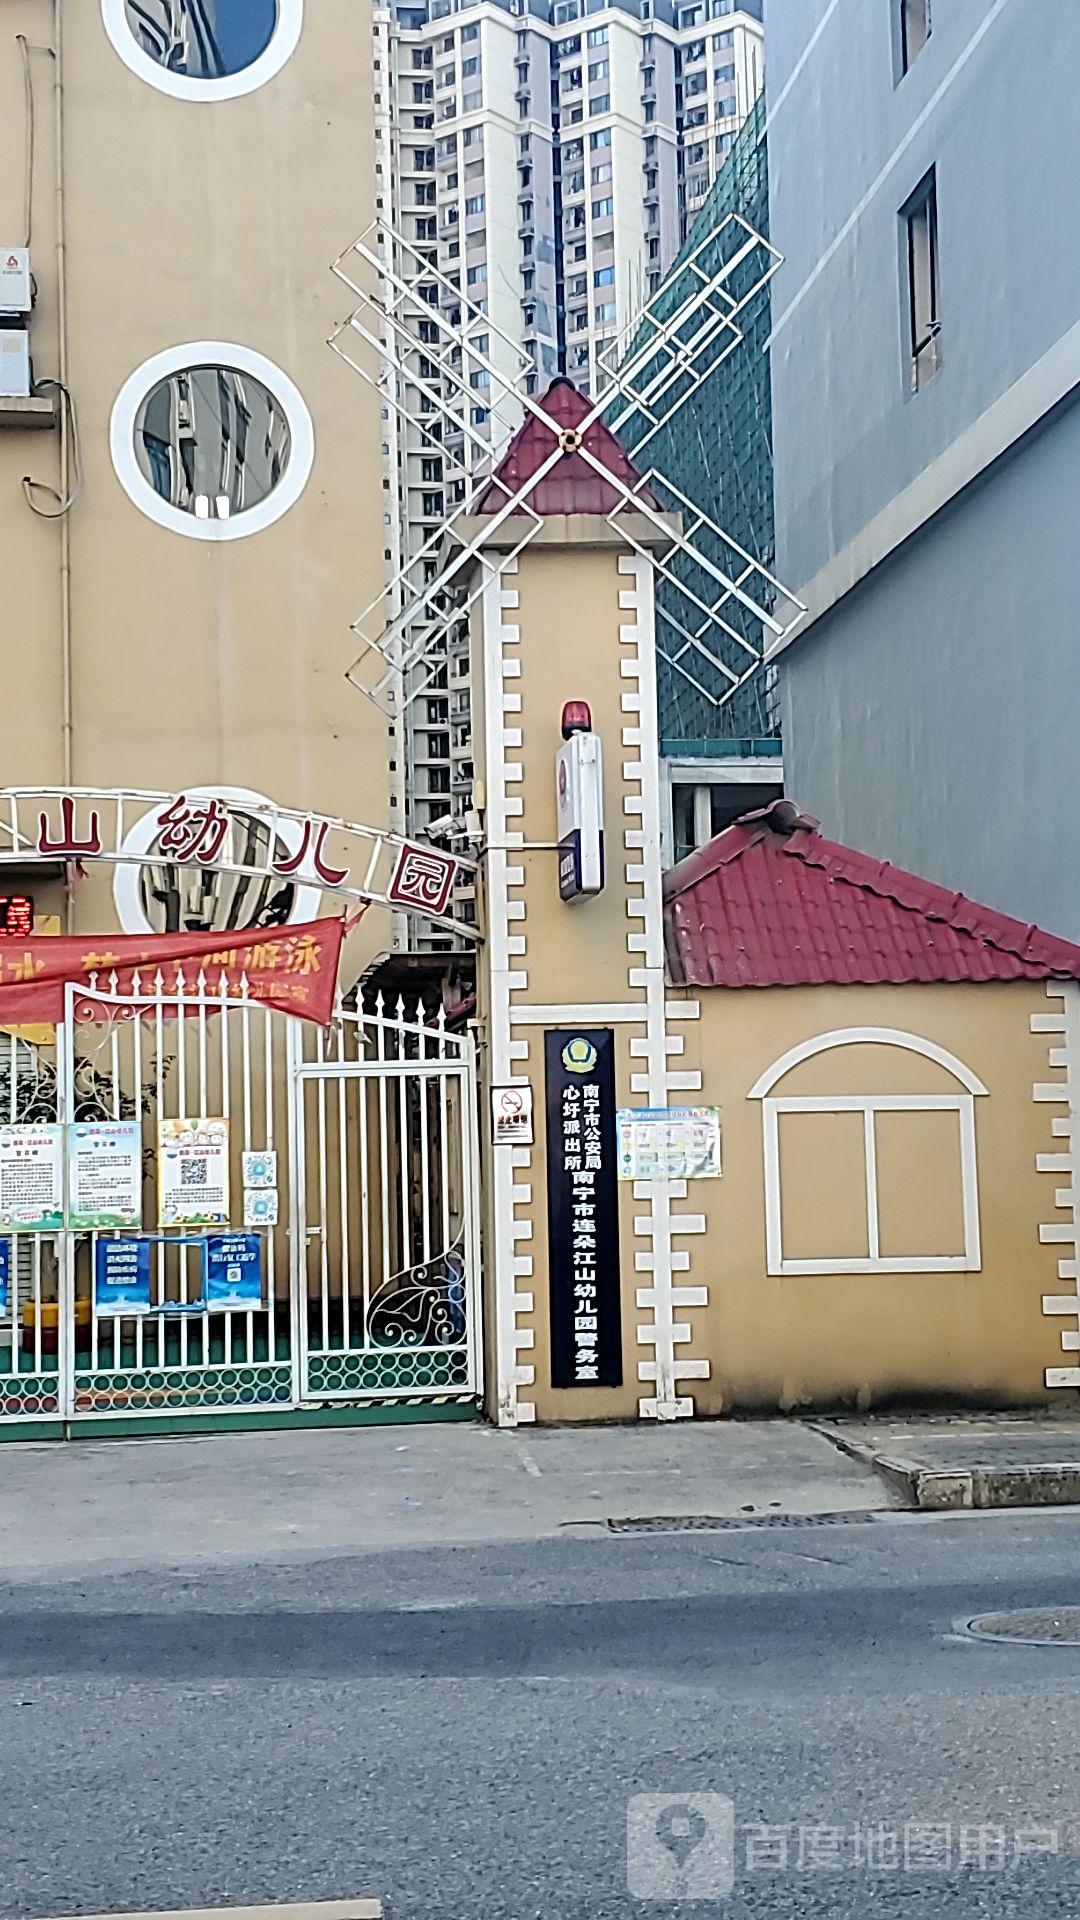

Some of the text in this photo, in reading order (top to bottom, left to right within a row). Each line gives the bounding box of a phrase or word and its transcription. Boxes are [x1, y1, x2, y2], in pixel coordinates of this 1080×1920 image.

[562, 1084, 582, 1171] 心圩派出所
[582, 1083, 602, 1170] 南宁市公安局
[571, 1170, 600, 1380] 南宁市连朵江山幼儿园警务室
